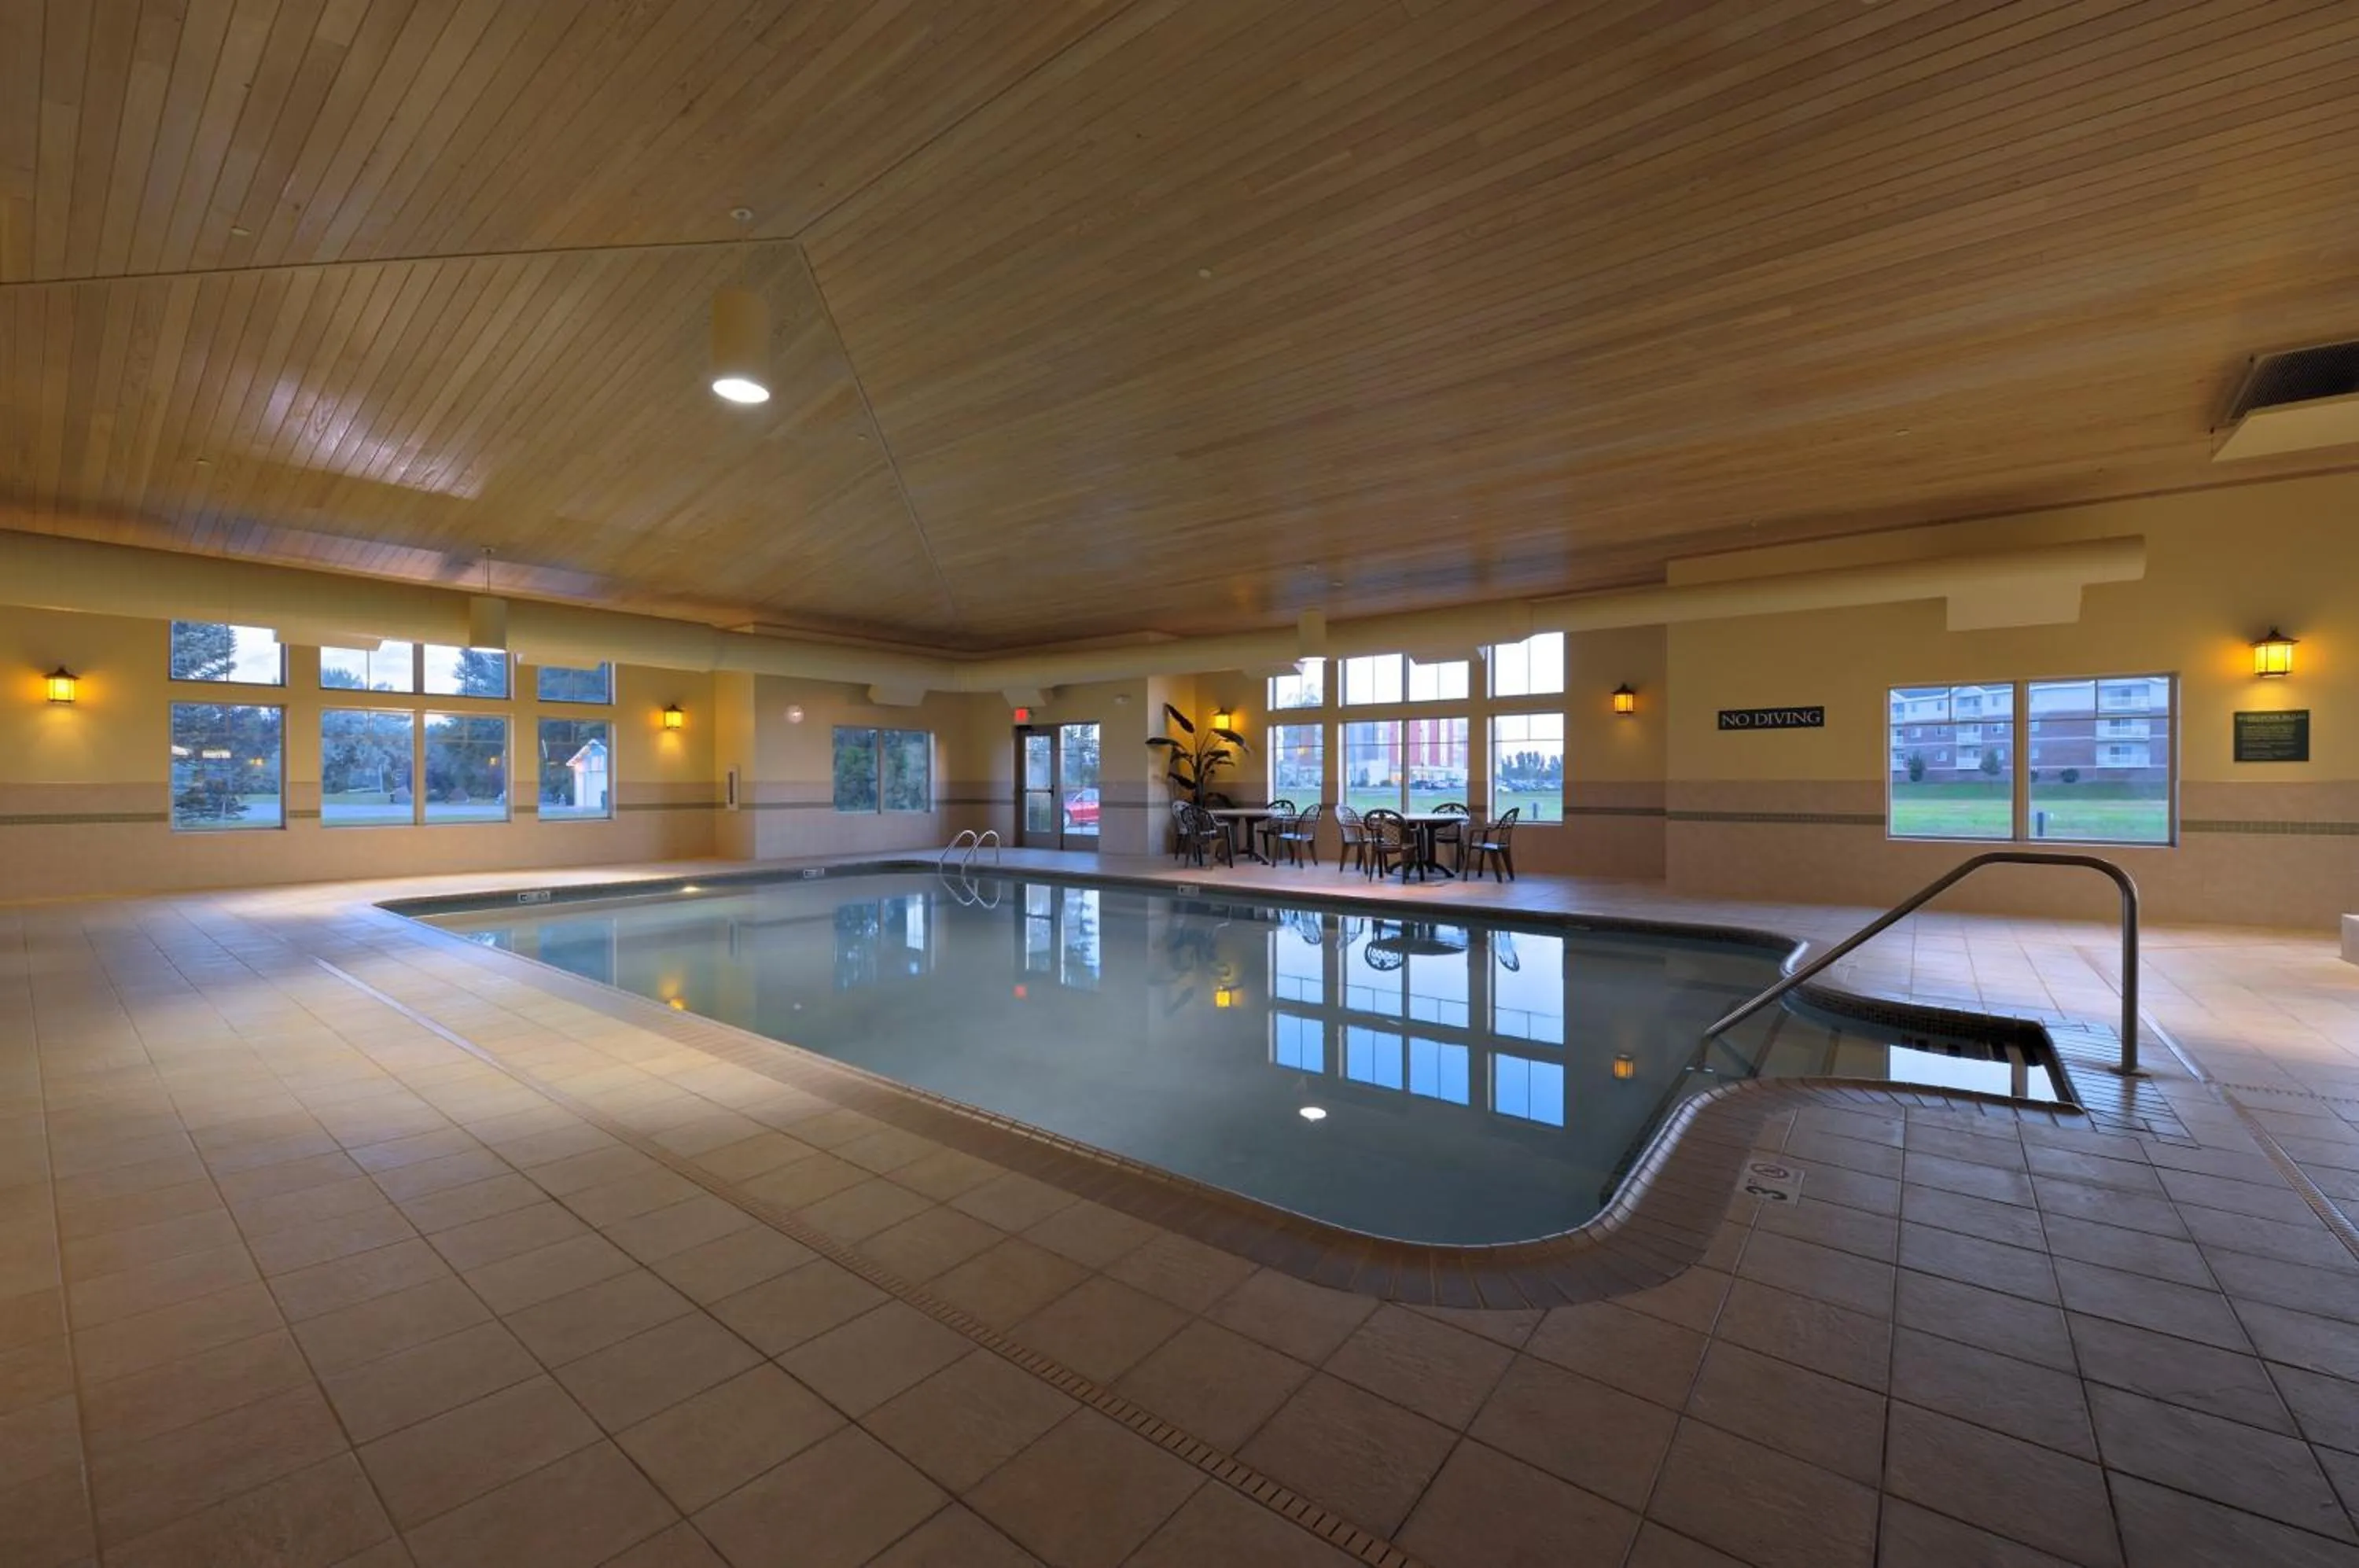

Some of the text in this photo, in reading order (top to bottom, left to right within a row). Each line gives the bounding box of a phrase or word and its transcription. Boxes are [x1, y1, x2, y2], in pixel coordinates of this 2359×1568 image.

[1721, 710, 1821, 727] NO DIVING
[1745, 1186, 1787, 1200] 3
